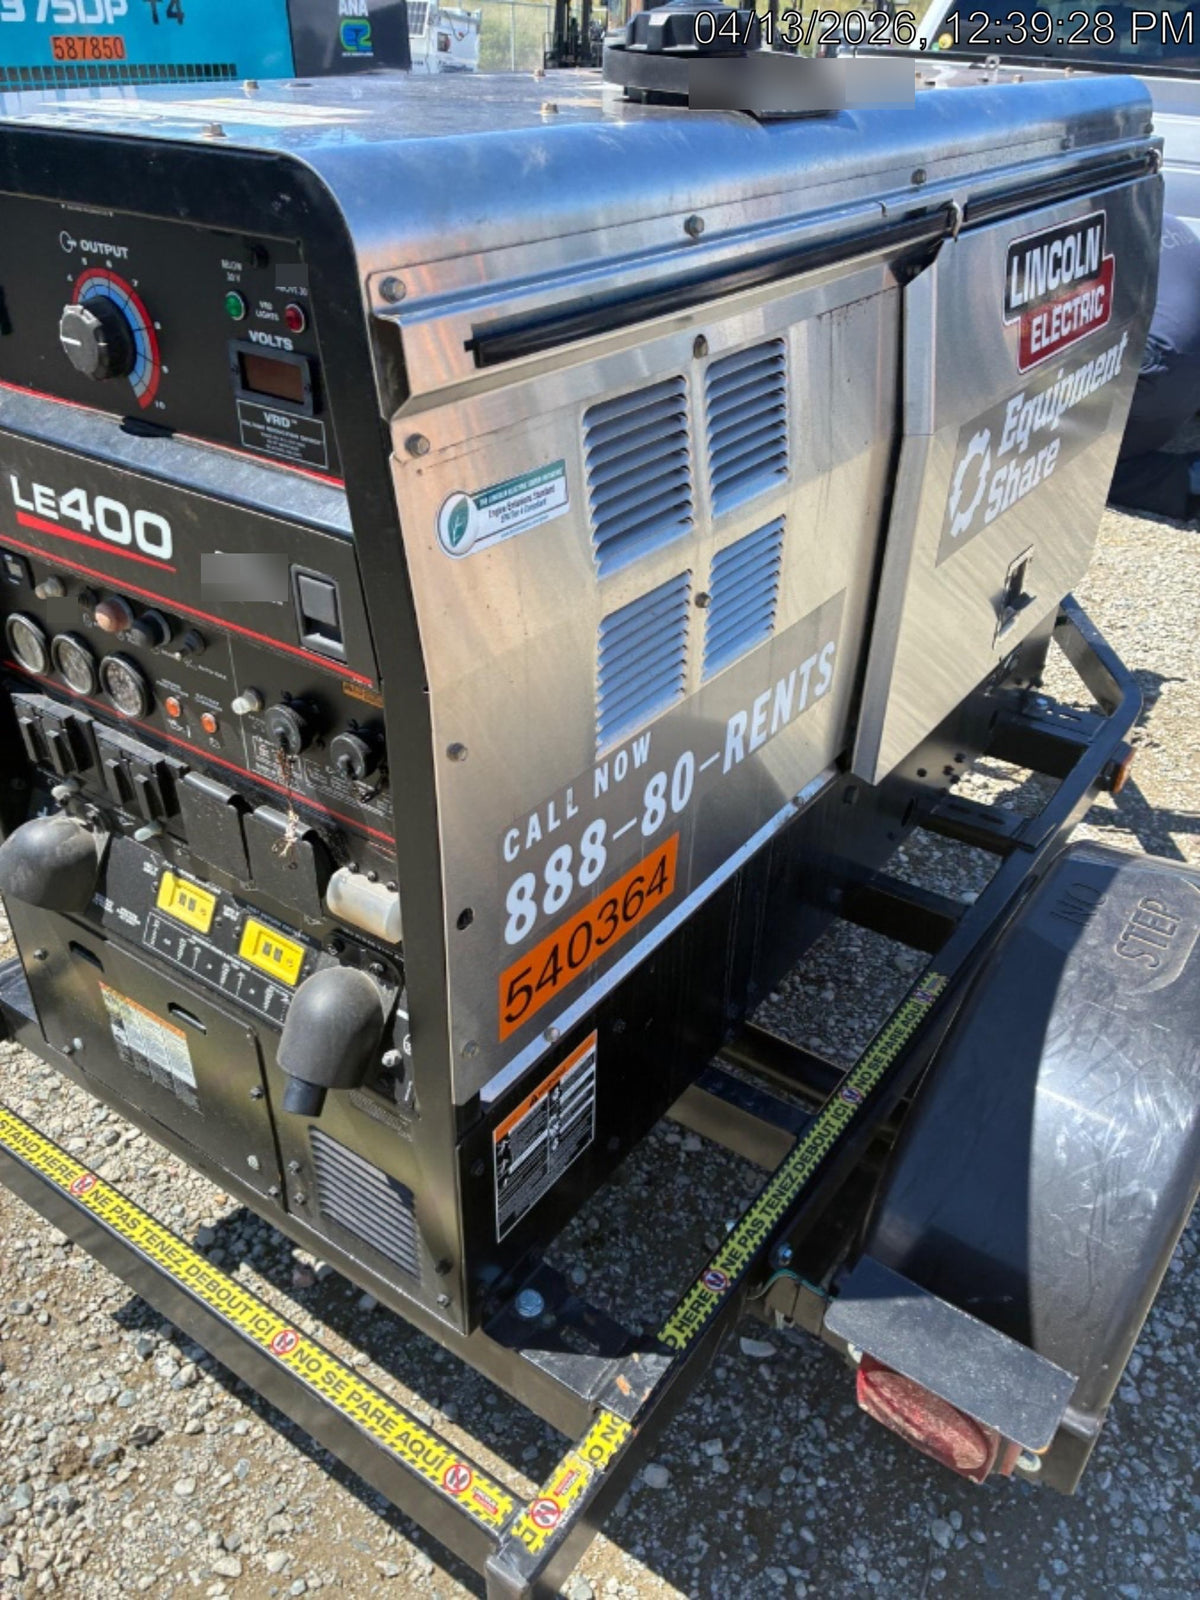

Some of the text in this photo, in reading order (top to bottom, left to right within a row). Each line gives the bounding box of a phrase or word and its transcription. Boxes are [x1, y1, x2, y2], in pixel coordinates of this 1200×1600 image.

[53, 36, 126, 60] 587850
[80, 239, 129, 259] OUTPUT
[1009, 225, 1101, 309] LINCOLN
[248, 329, 294, 351] VOLTS
[1031, 284, 1105, 354] ELECTRIC
[996, 331, 1129, 457] Equipment
[10, 474, 173, 560] LE400
[984, 437, 1061, 525] Share
[503, 731, 652, 863] CALL NOW
[504, 640, 836, 946] 888-80-RENTS
[505, 853, 668, 1024] 540364
[1114, 896, 1183, 970] STEP
[856, 1071, 872, 1087] NO
[867, 1054, 882, 1071] SE
[0, 1119, 79, 1181] STAND HERE
[719, 1103, 851, 1272] NE PAS TENEZ DEBOUT ICI
[88, 1189, 277, 1336] NE PAS TENEZ DEBOUT ICI
[674, 1289, 714, 1334] HERE
[292, 1346, 323, 1373] NO
[321, 1369, 350, 1395] SE
[345, 1389, 399, 1434] PARE
